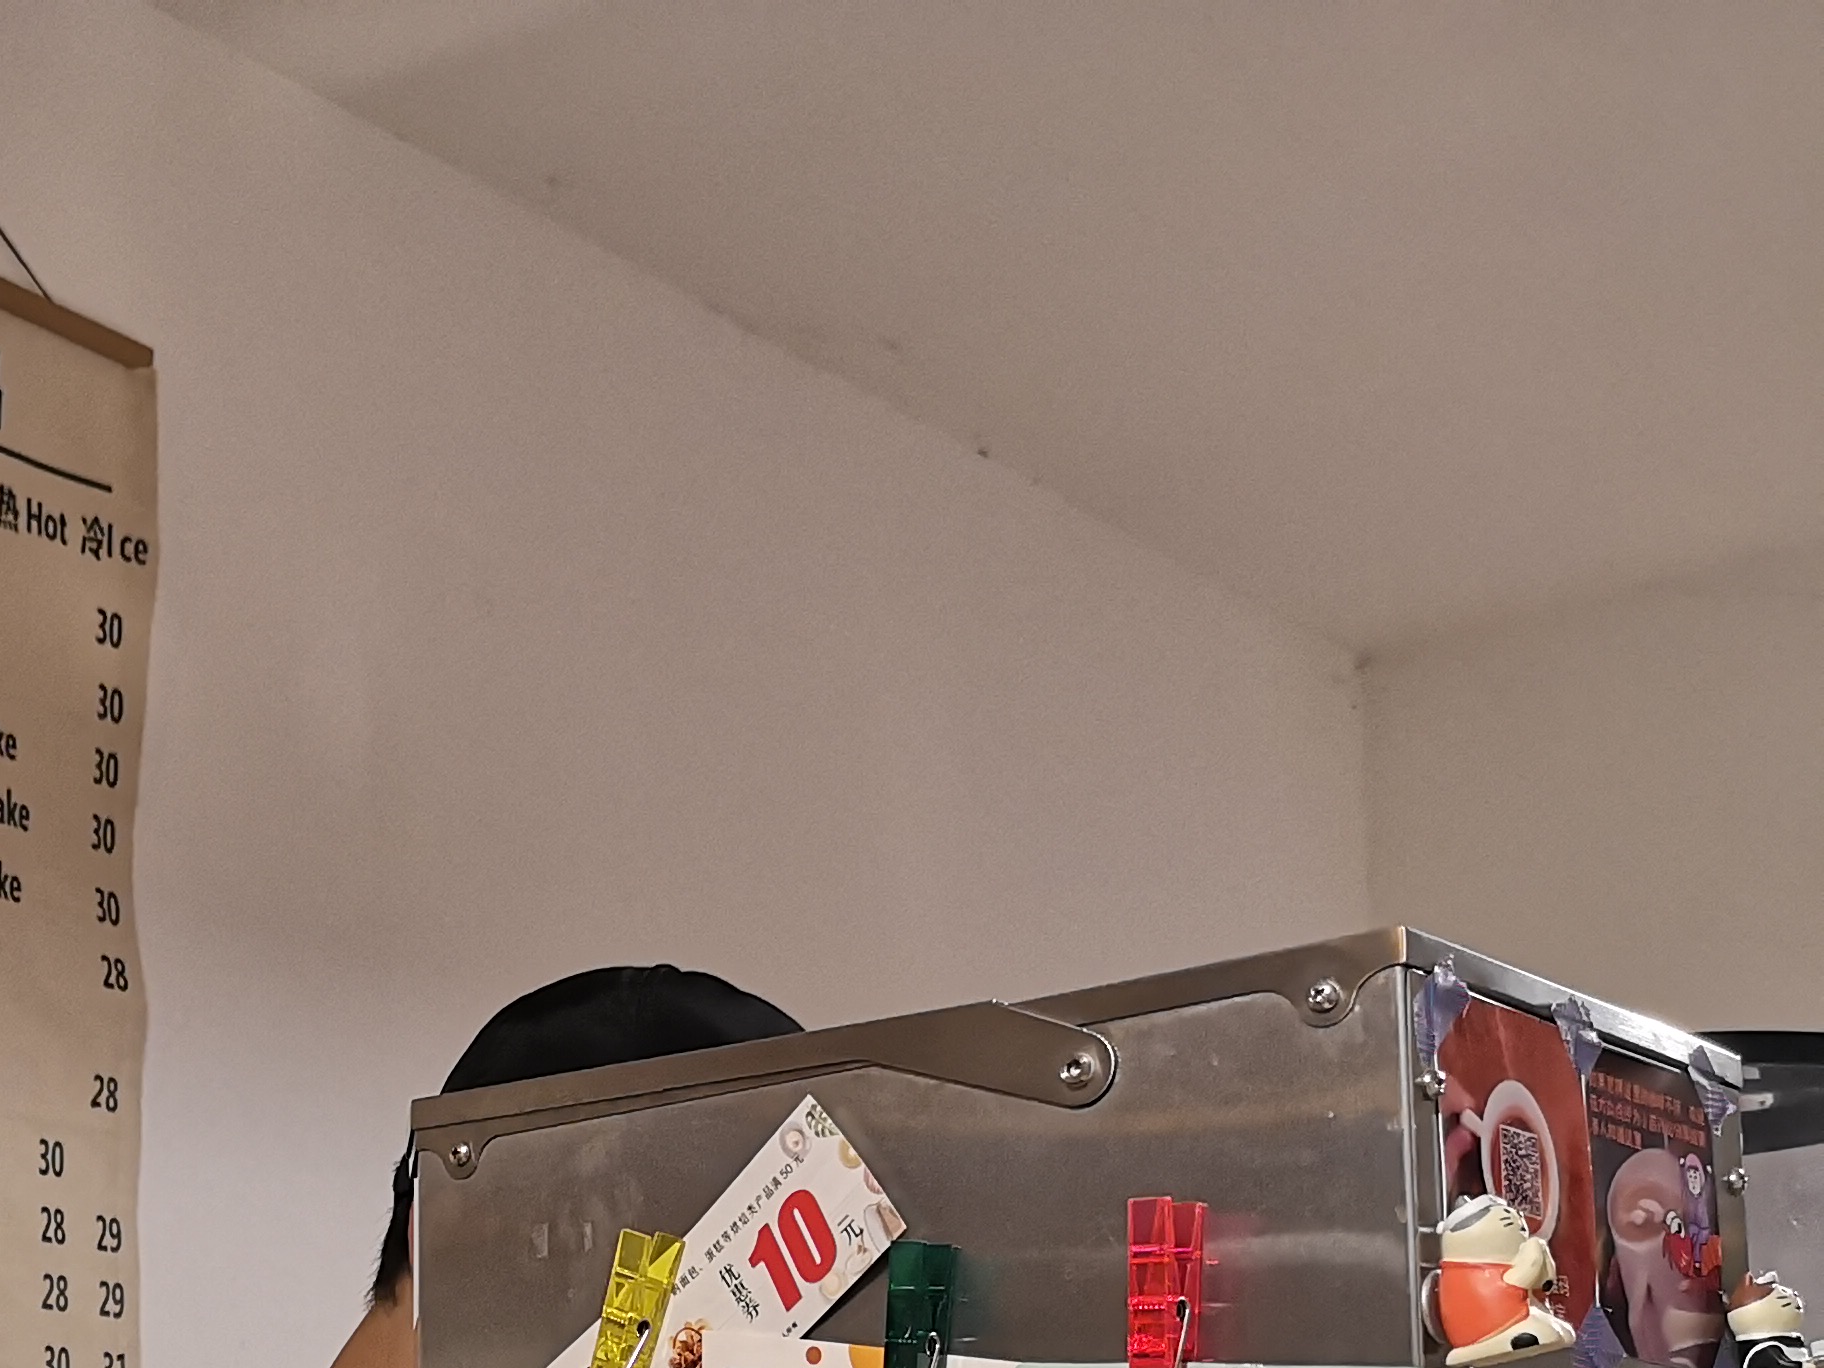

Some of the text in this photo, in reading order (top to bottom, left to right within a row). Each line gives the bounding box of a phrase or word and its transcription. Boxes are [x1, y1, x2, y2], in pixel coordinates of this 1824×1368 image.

[27, 497, 67, 546] Hot
[96, 608, 122, 649] 30
[95, 887, 120, 926] 30
[101, 955, 128, 992] 28
[91, 1074, 118, 1113] 28
[39, 1138, 64, 1177] 30
[41, 1206, 121, 1253] 28 29
[747, 1189, 837, 1313] 10
[42, 1273, 124, 1319] 28 29
